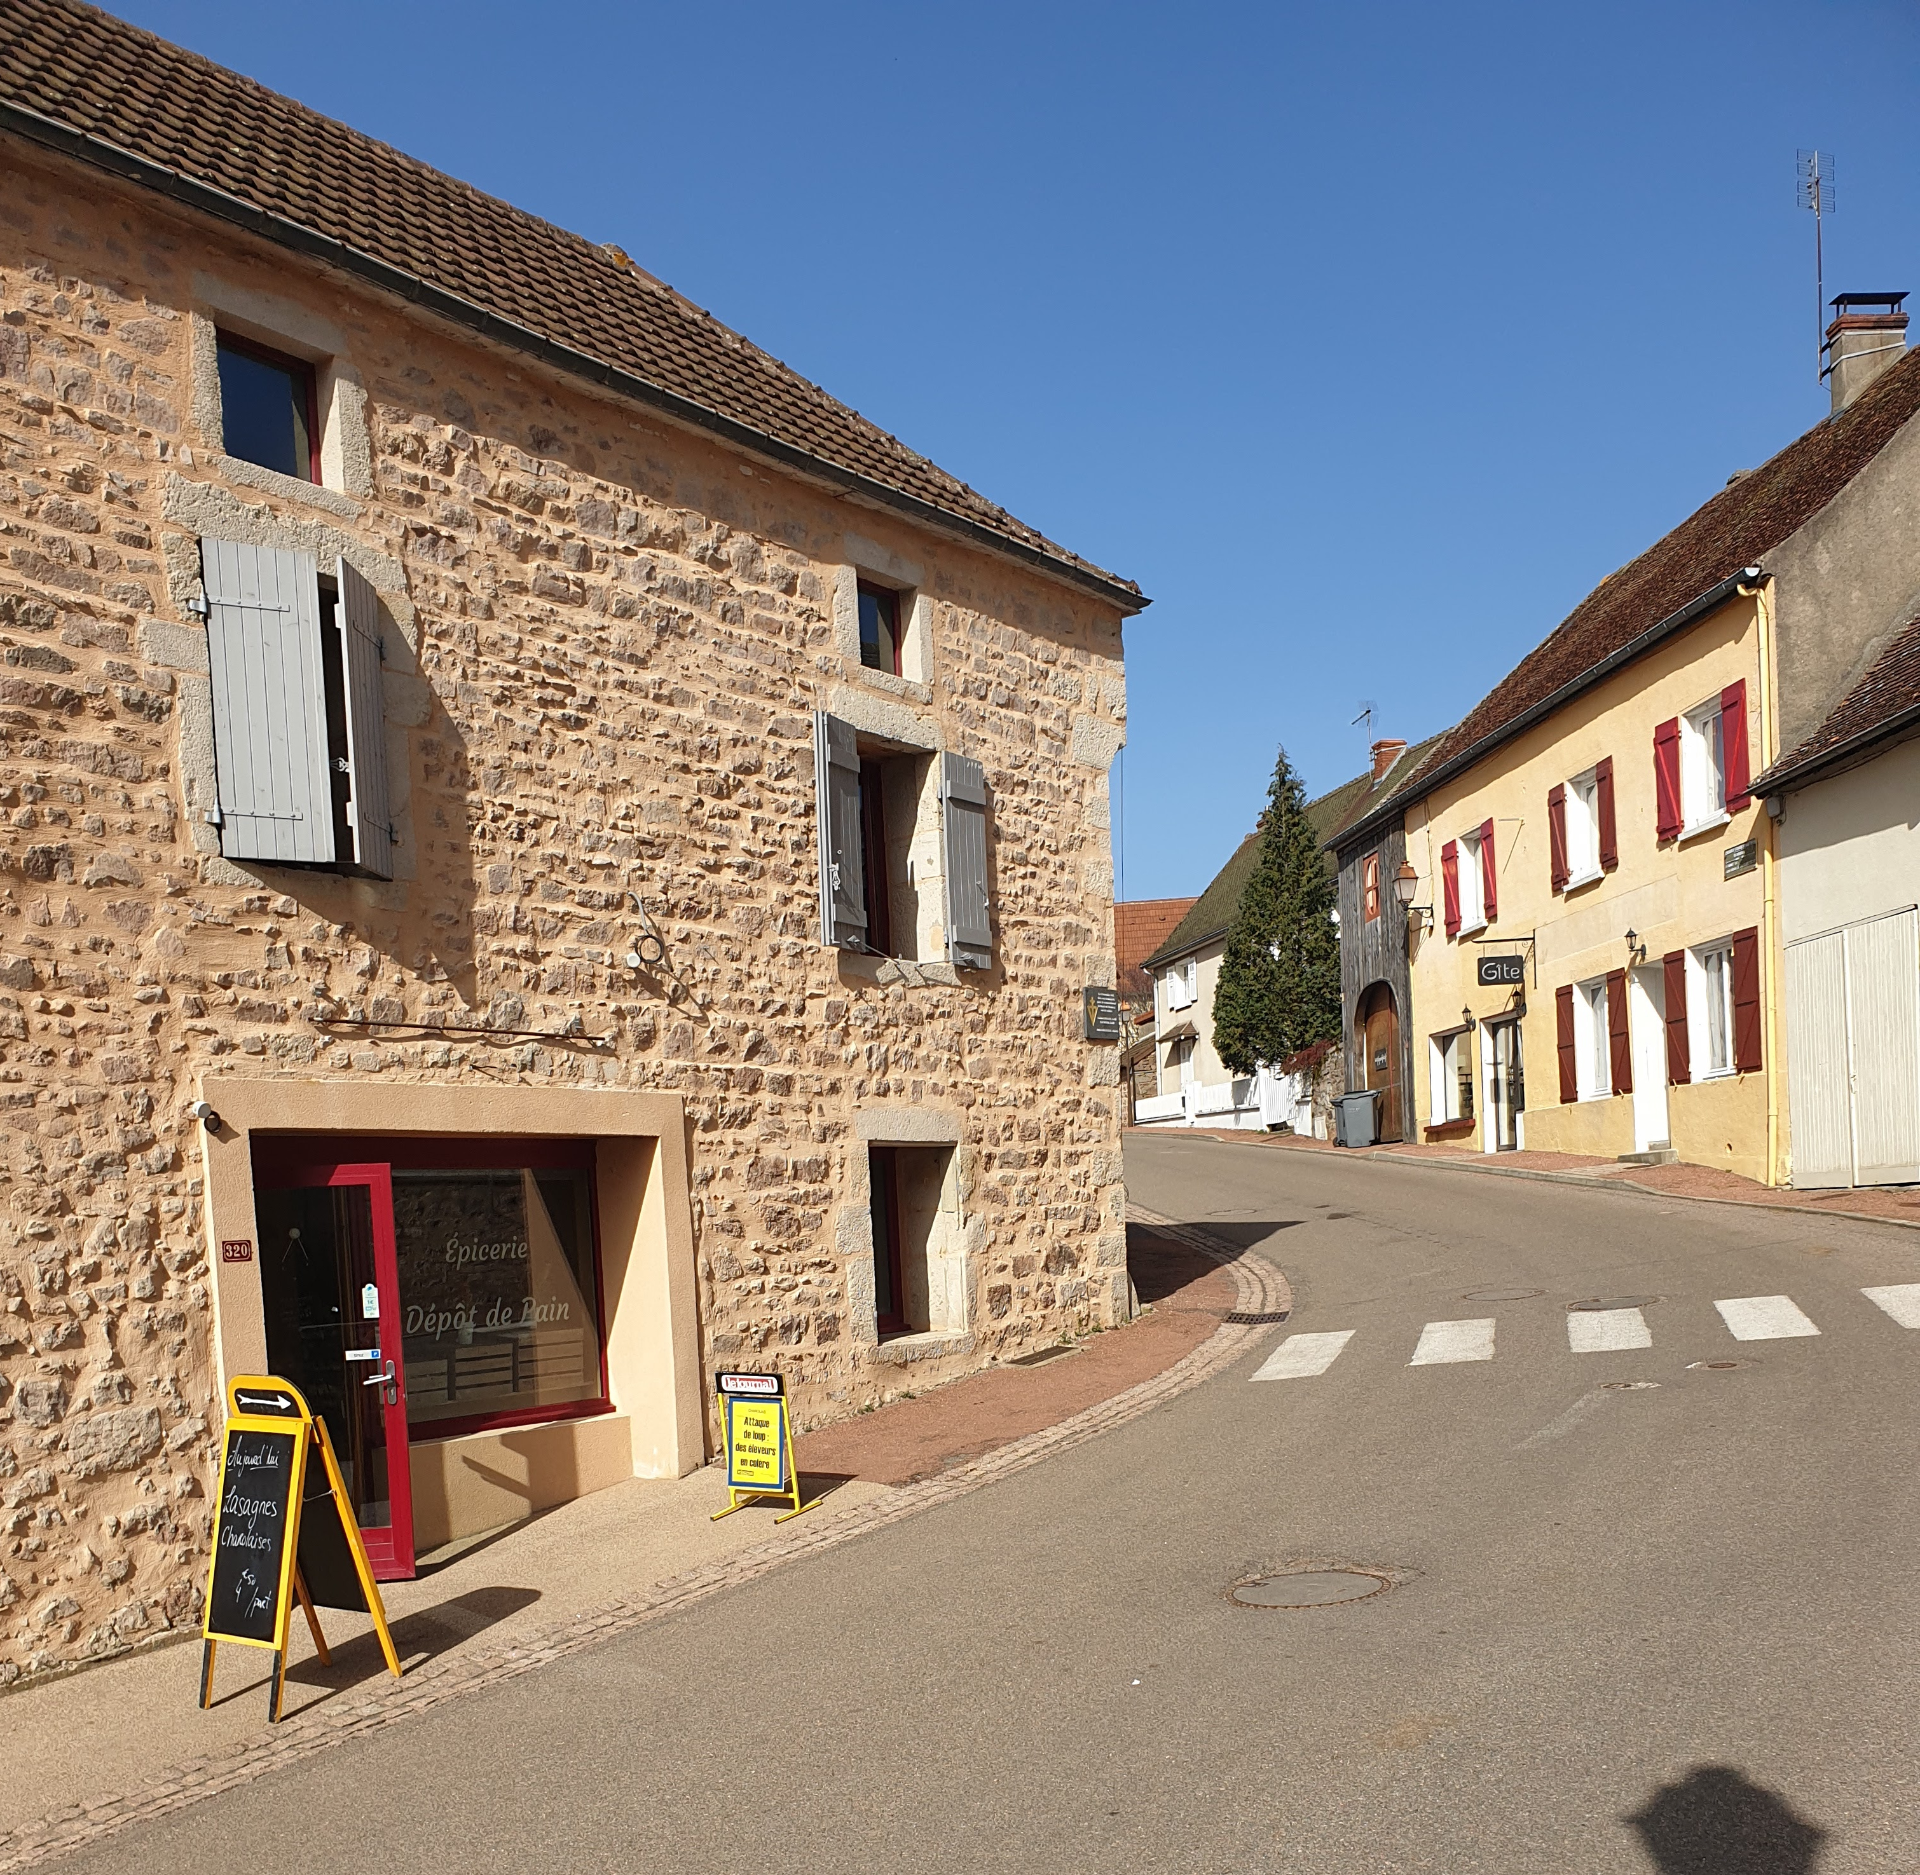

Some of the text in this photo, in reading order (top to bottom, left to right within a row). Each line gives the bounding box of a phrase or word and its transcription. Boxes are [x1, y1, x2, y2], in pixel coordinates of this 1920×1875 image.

[1481, 962, 1520, 980] Gîte
[225, 1244, 248, 1257] 320
[445, 1232, 528, 1271] Épicerie
[406, 1296, 569, 1341] Dépôt de Pain
[743, 1416, 770, 1428] Attaque
[743, 1429, 752, 1439] de
[752, 1430, 766, 1442] loup
[735, 1442, 747, 1453] des
[740, 1458, 748, 1467] en
[222, 1484, 278, 1530] Lasagnes
